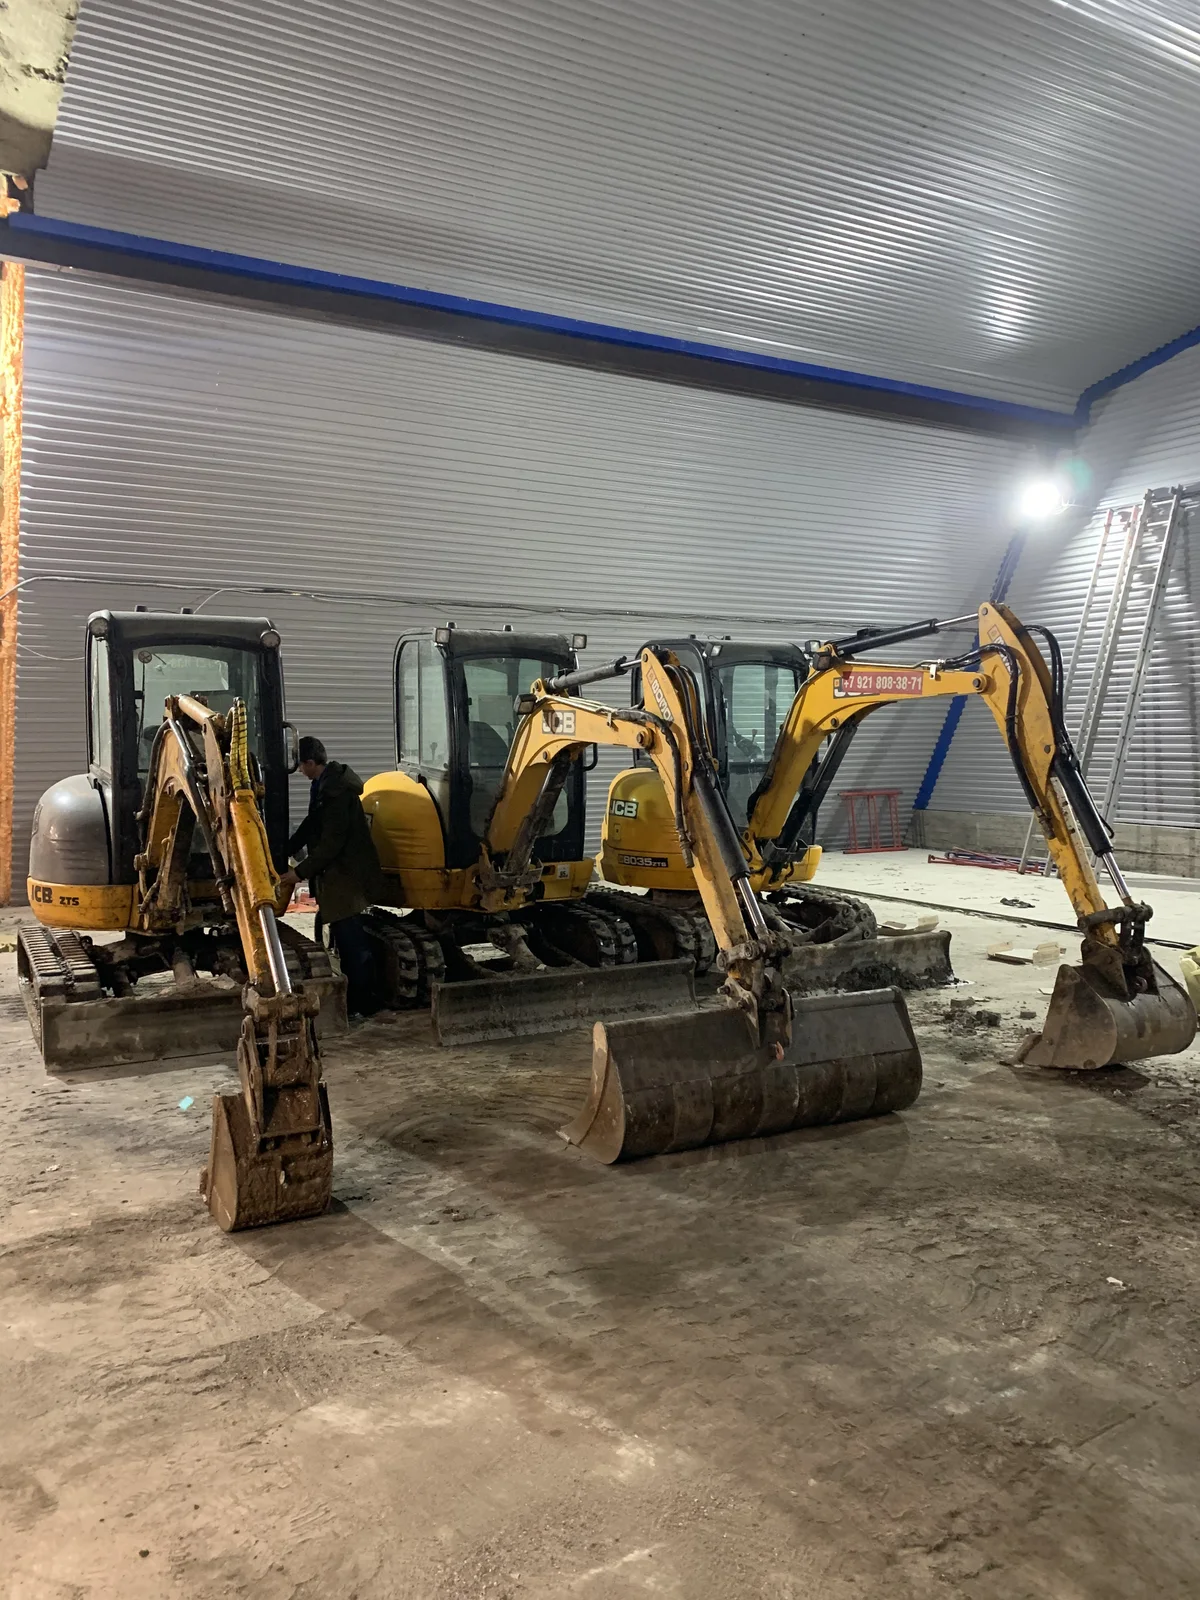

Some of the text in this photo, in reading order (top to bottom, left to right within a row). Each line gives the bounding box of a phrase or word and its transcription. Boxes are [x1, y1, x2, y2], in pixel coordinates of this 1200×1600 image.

[844, 676, 922, 690] +7 921 808-38-71
[542, 710, 575, 733] JCB
[611, 800, 637, 817] JCB
[59, 896, 79, 906] ZTS
